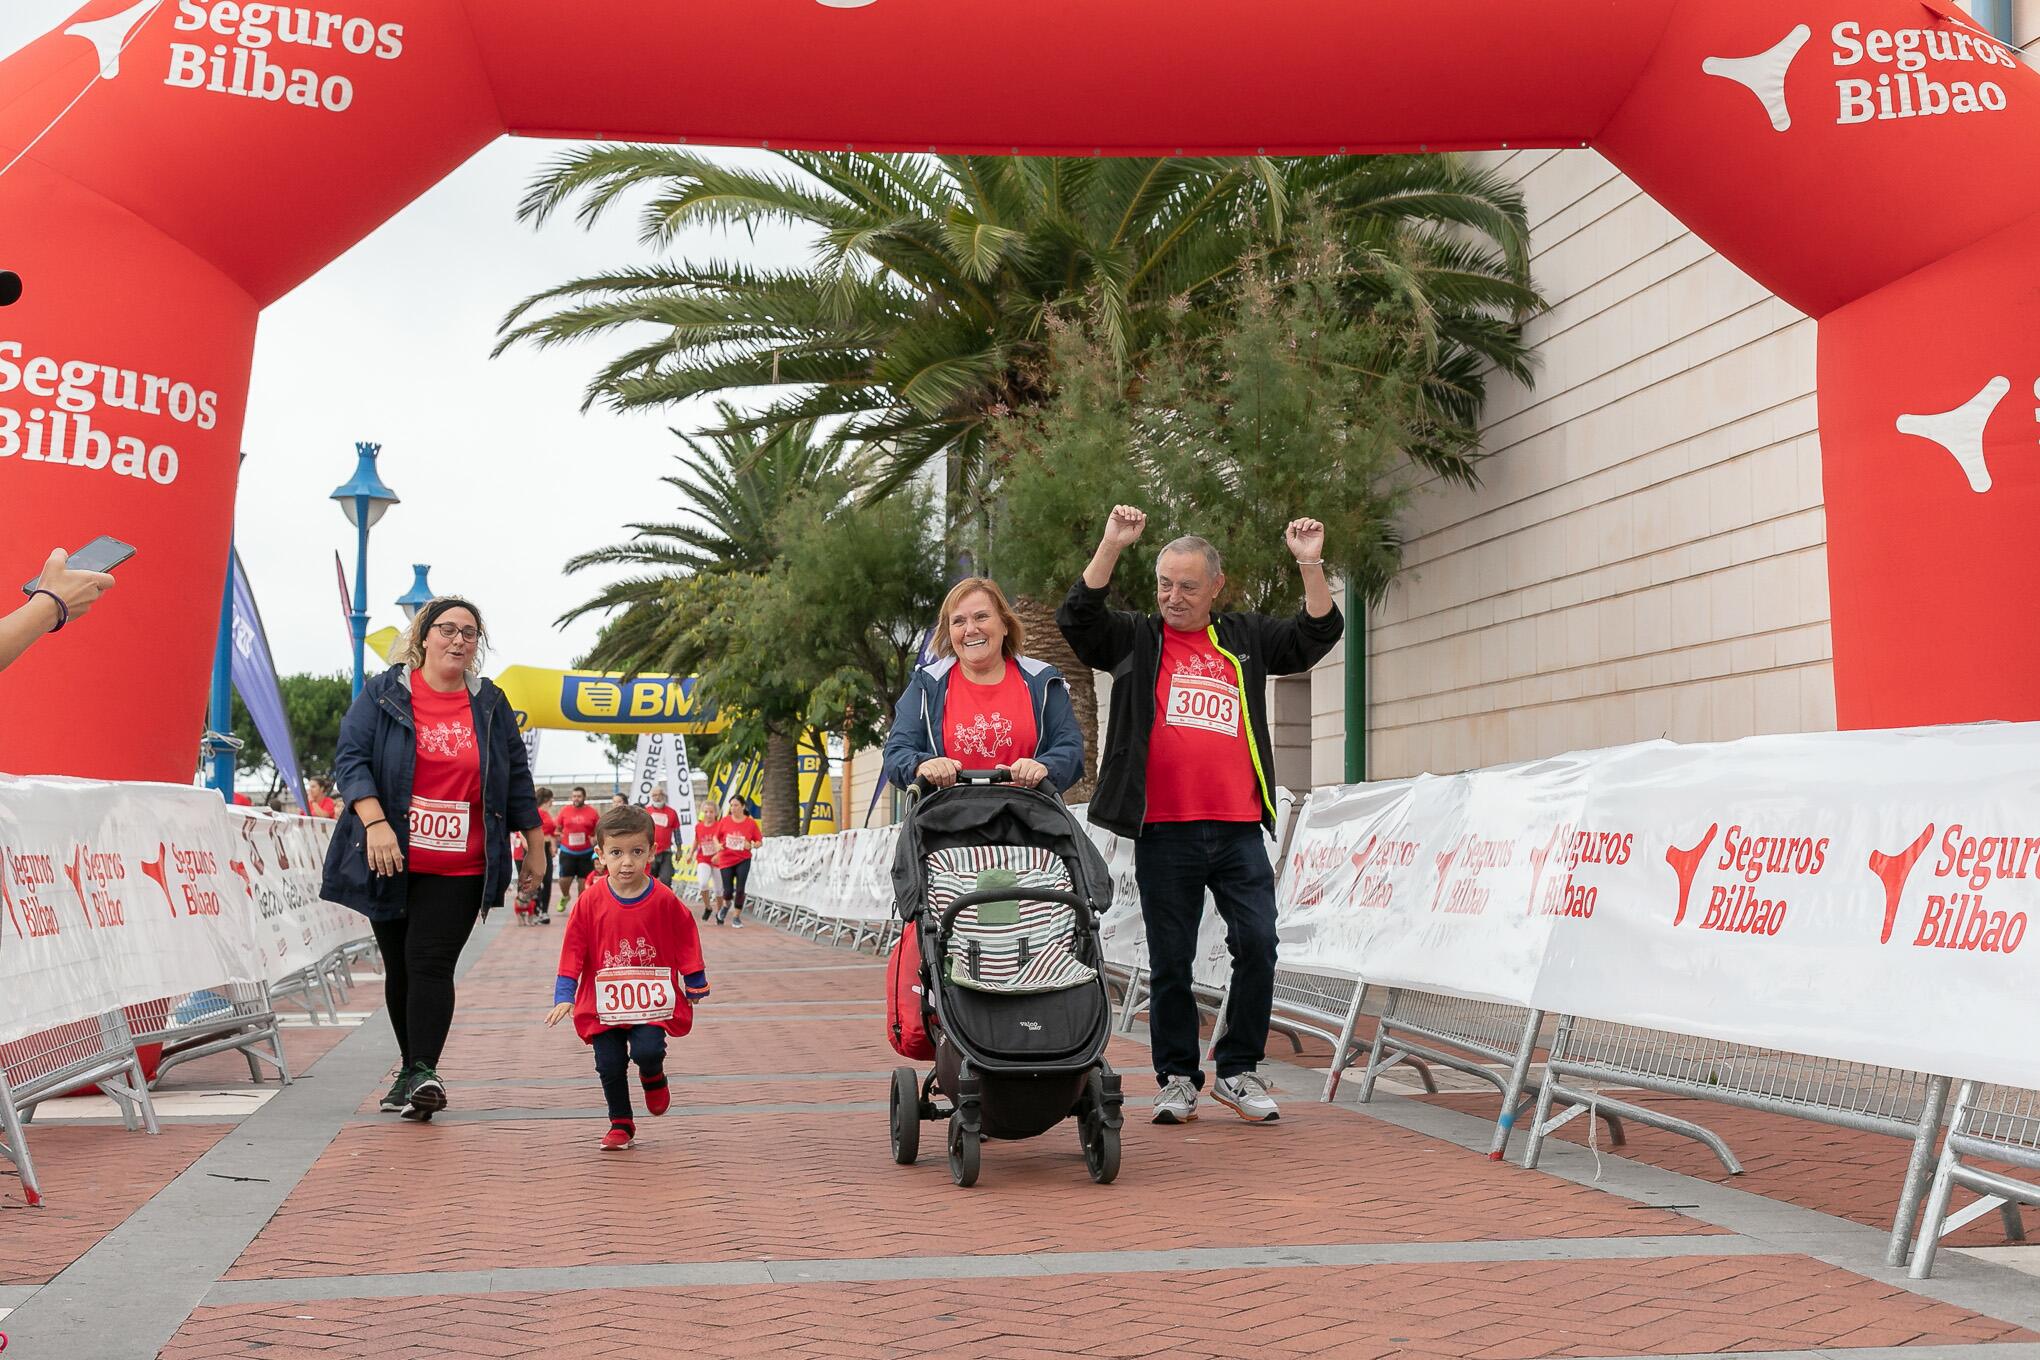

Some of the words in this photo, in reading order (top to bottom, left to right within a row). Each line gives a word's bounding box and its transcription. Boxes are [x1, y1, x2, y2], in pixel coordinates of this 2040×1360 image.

[174, 0, 404, 60] Seguros
[1831, 21, 2017, 72] Seguros
[163, 42, 353, 112] Bilbao
[1835, 72, 2007, 125] Bilbao
[0, 341, 218, 430] Seguros
[0, 407, 179, 485] Bilbao
[630, 683, 694, 717] BM
[1176, 690, 1233, 722] 3003
[674, 733, 689, 797] CORR
[409, 810, 461, 839] 3003
[681, 801, 692, 826] EL
[1717, 824, 1829, 882] Seguros
[1934, 823, 2040, 891] Segur
[1540, 873, 1598, 919] Bilbao
[1699, 884, 1787, 936] Bilbao
[1912, 892, 2028, 954] Bilbao
[604, 983, 667, 1011] 3003
